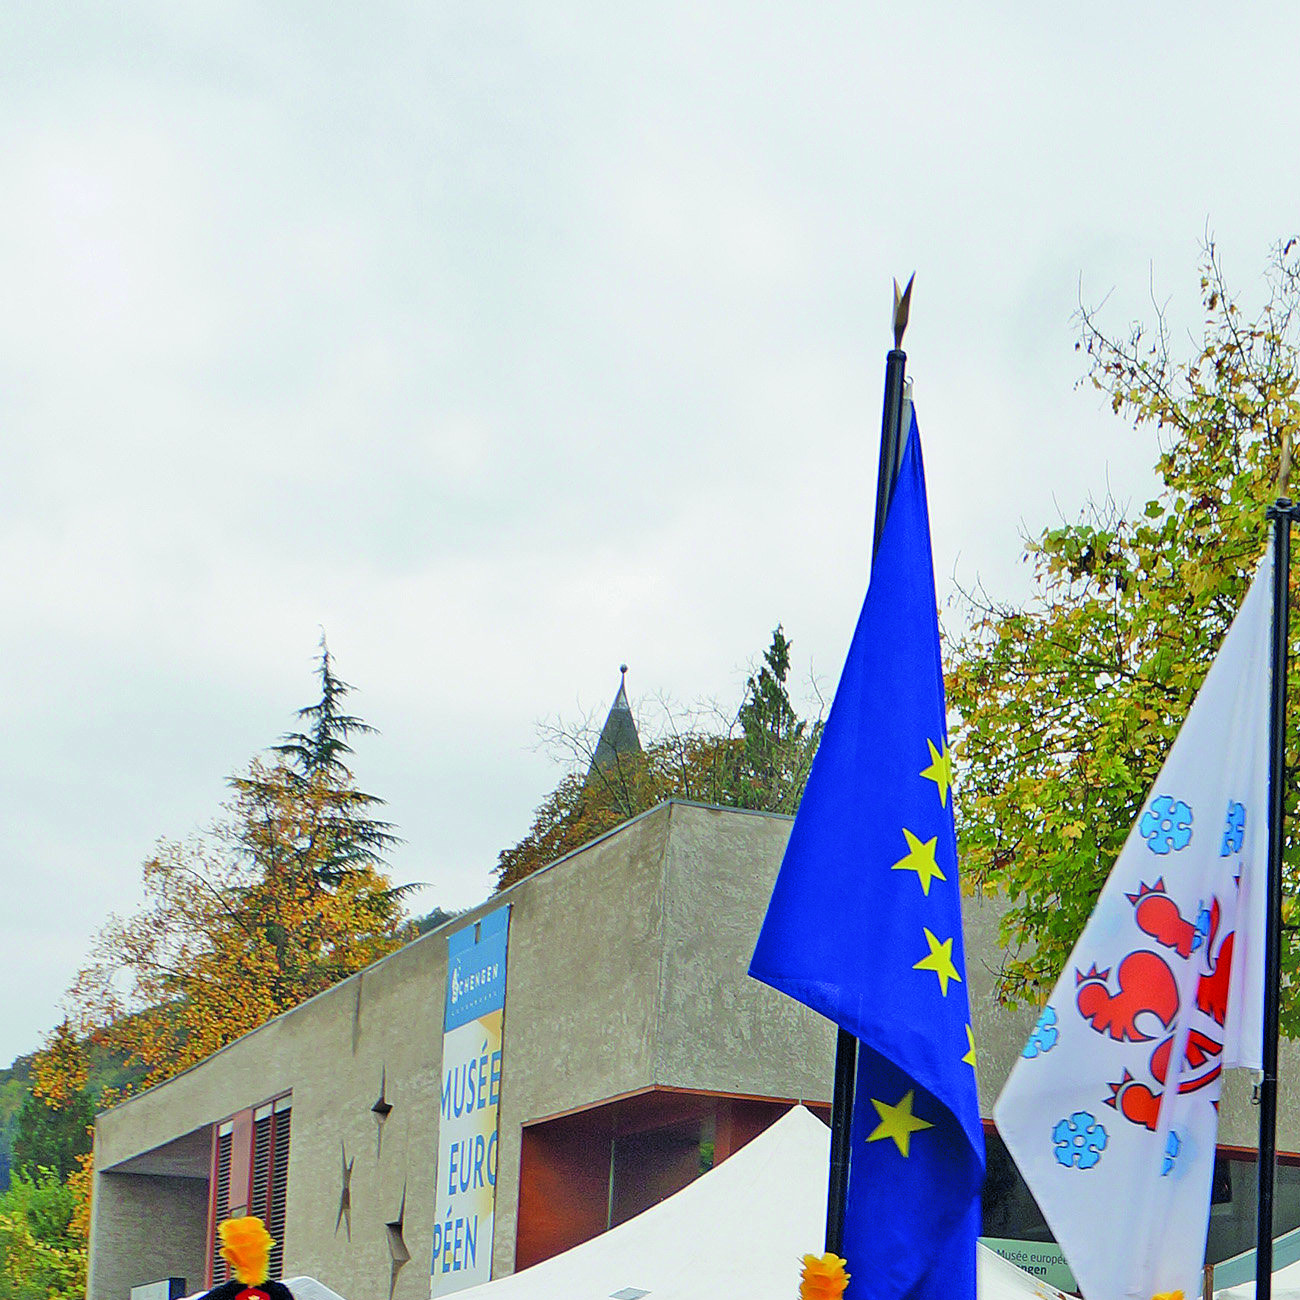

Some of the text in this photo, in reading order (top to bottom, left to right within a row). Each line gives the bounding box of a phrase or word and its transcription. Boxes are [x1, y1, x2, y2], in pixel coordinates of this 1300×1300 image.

[441, 1040, 501, 1120] MUSÉE
[430, 1205, 478, 1275] PÉEN
[997, 1249, 1028, 1261] Musée
[1016, 1264, 1047, 1275] ngen
